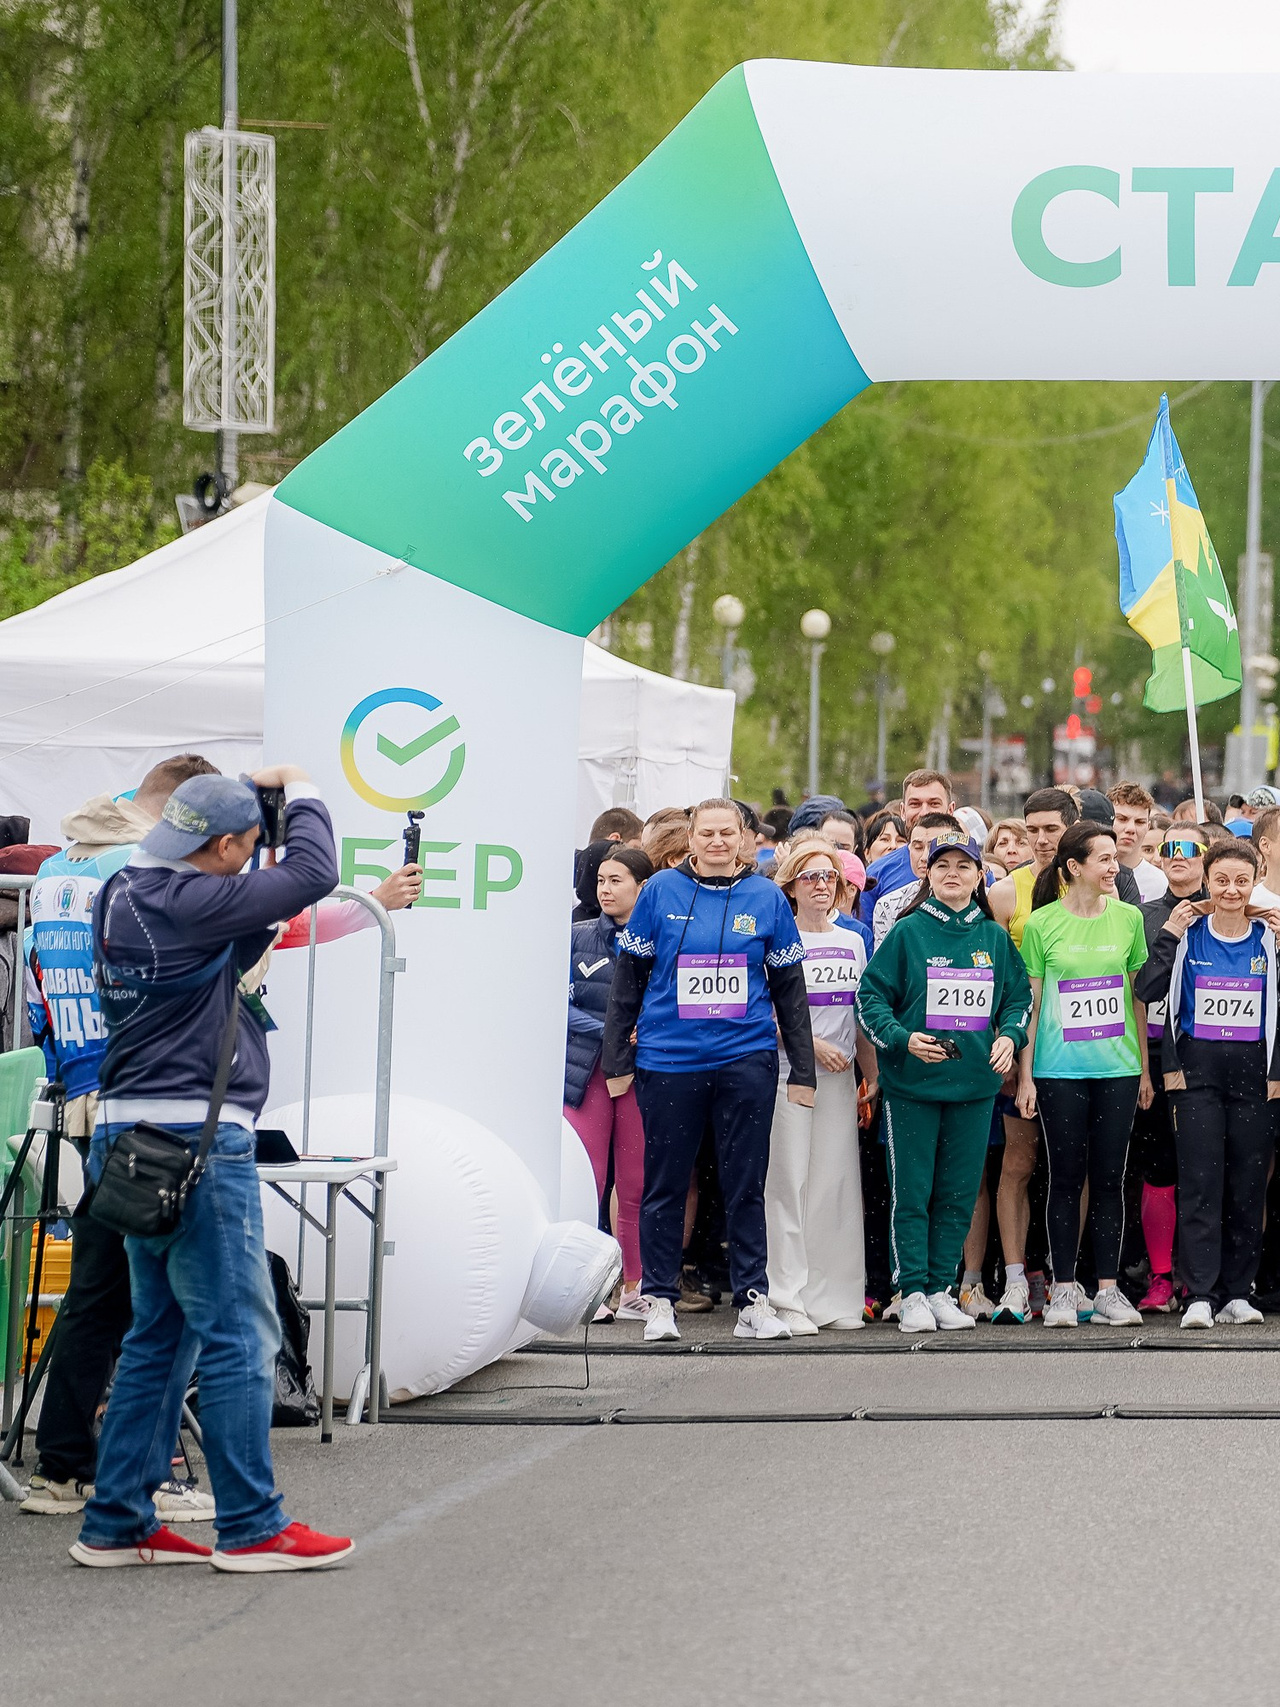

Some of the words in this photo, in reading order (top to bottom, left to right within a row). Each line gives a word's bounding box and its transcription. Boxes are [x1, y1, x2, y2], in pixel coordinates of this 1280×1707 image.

[462, 248, 699, 478] зелёный
[501, 302, 740, 523] марафон
[340, 836, 524, 911] БЕР
[72, 930, 92, 951] ЮГР
[688, 975, 740, 995] 2000
[811, 966, 858, 984] 2244
[937, 987, 986, 1007] 2186
[1069, 996, 1119, 1018] 2100
[1203, 997, 1255, 1018] 2074
